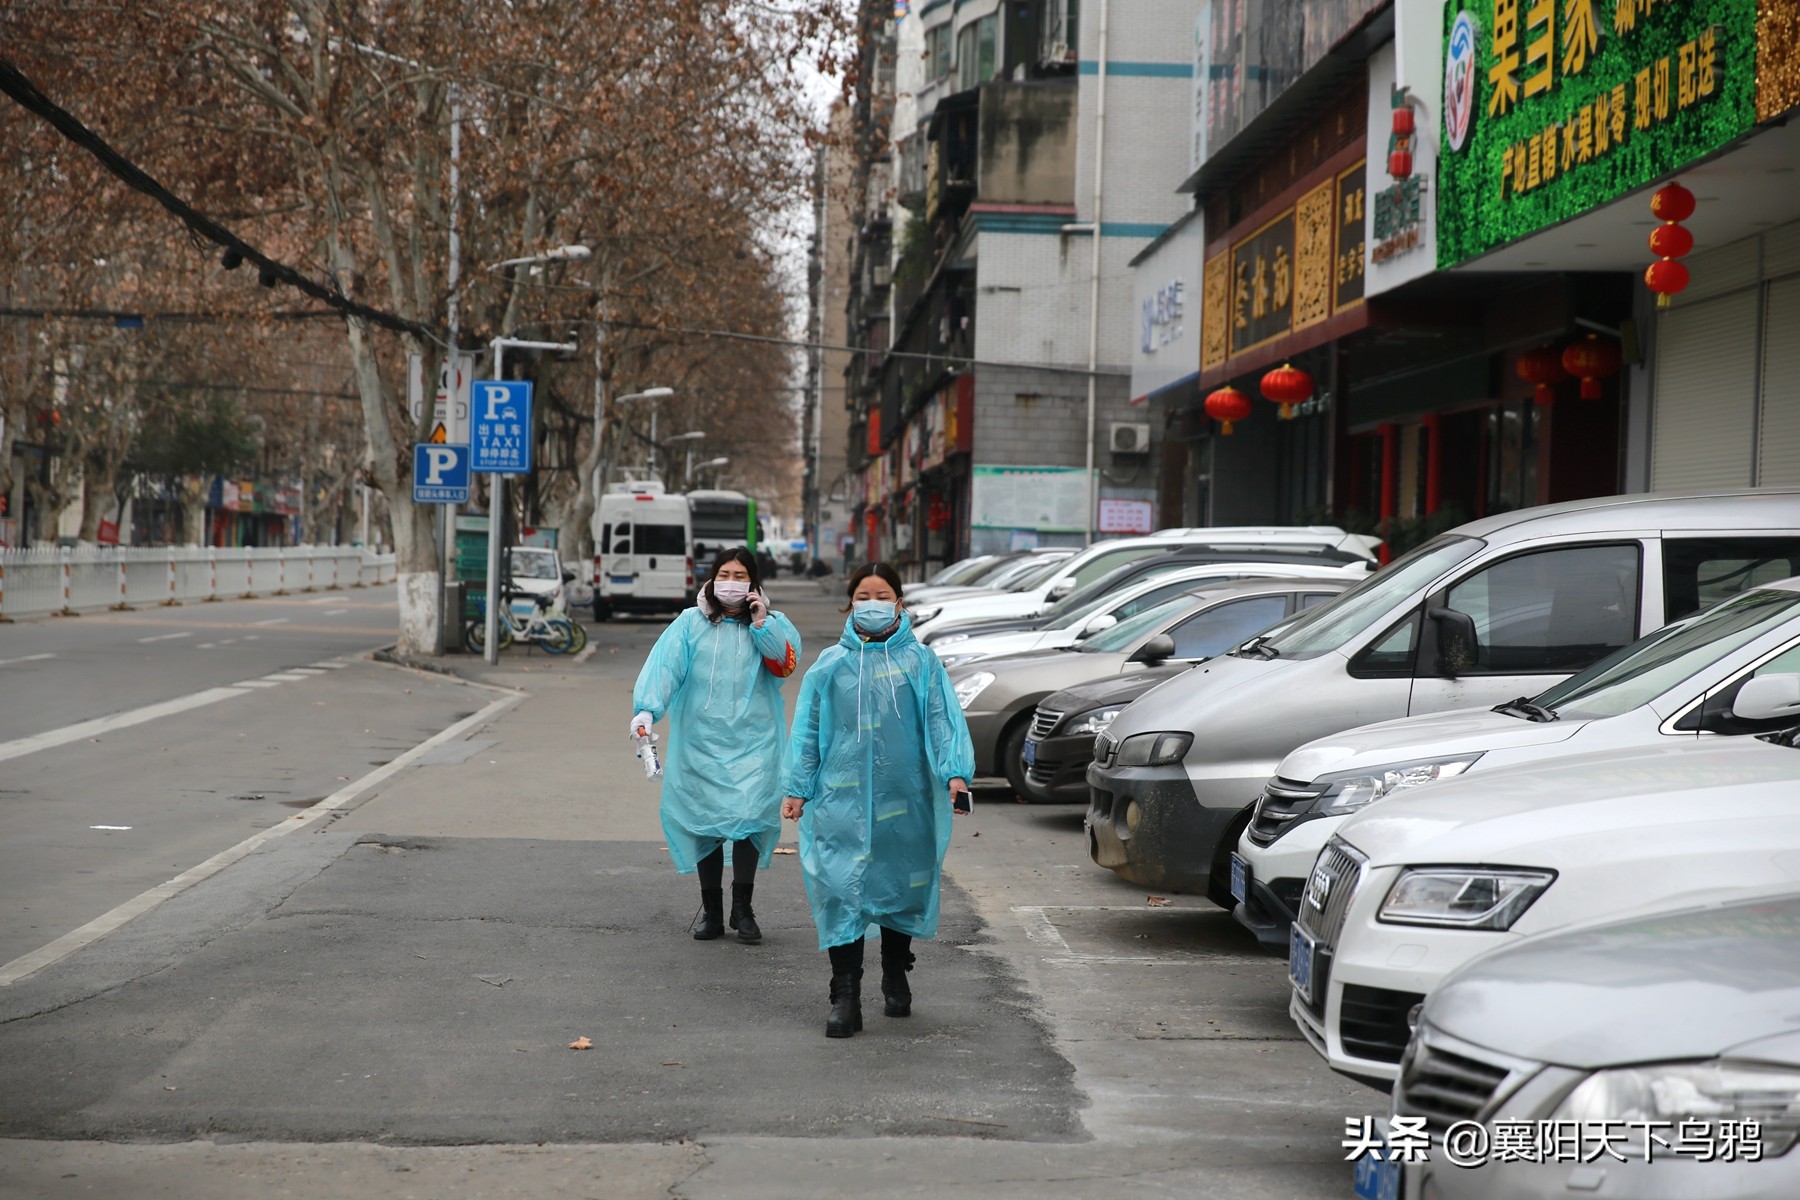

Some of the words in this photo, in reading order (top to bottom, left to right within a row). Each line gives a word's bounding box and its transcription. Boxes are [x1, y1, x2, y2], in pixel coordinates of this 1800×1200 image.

[1500, 122, 1556, 199] 产地直销
[1561, 83, 1626, 171] 水果批零
[1635, 56, 1669, 130] 现切
[1677, 25, 1715, 110] 配送
[484, 386, 511, 420] P
[478, 423, 521, 436] 出租车
[481, 436, 520, 448] TAXI
[425, 448, 458, 484] P
